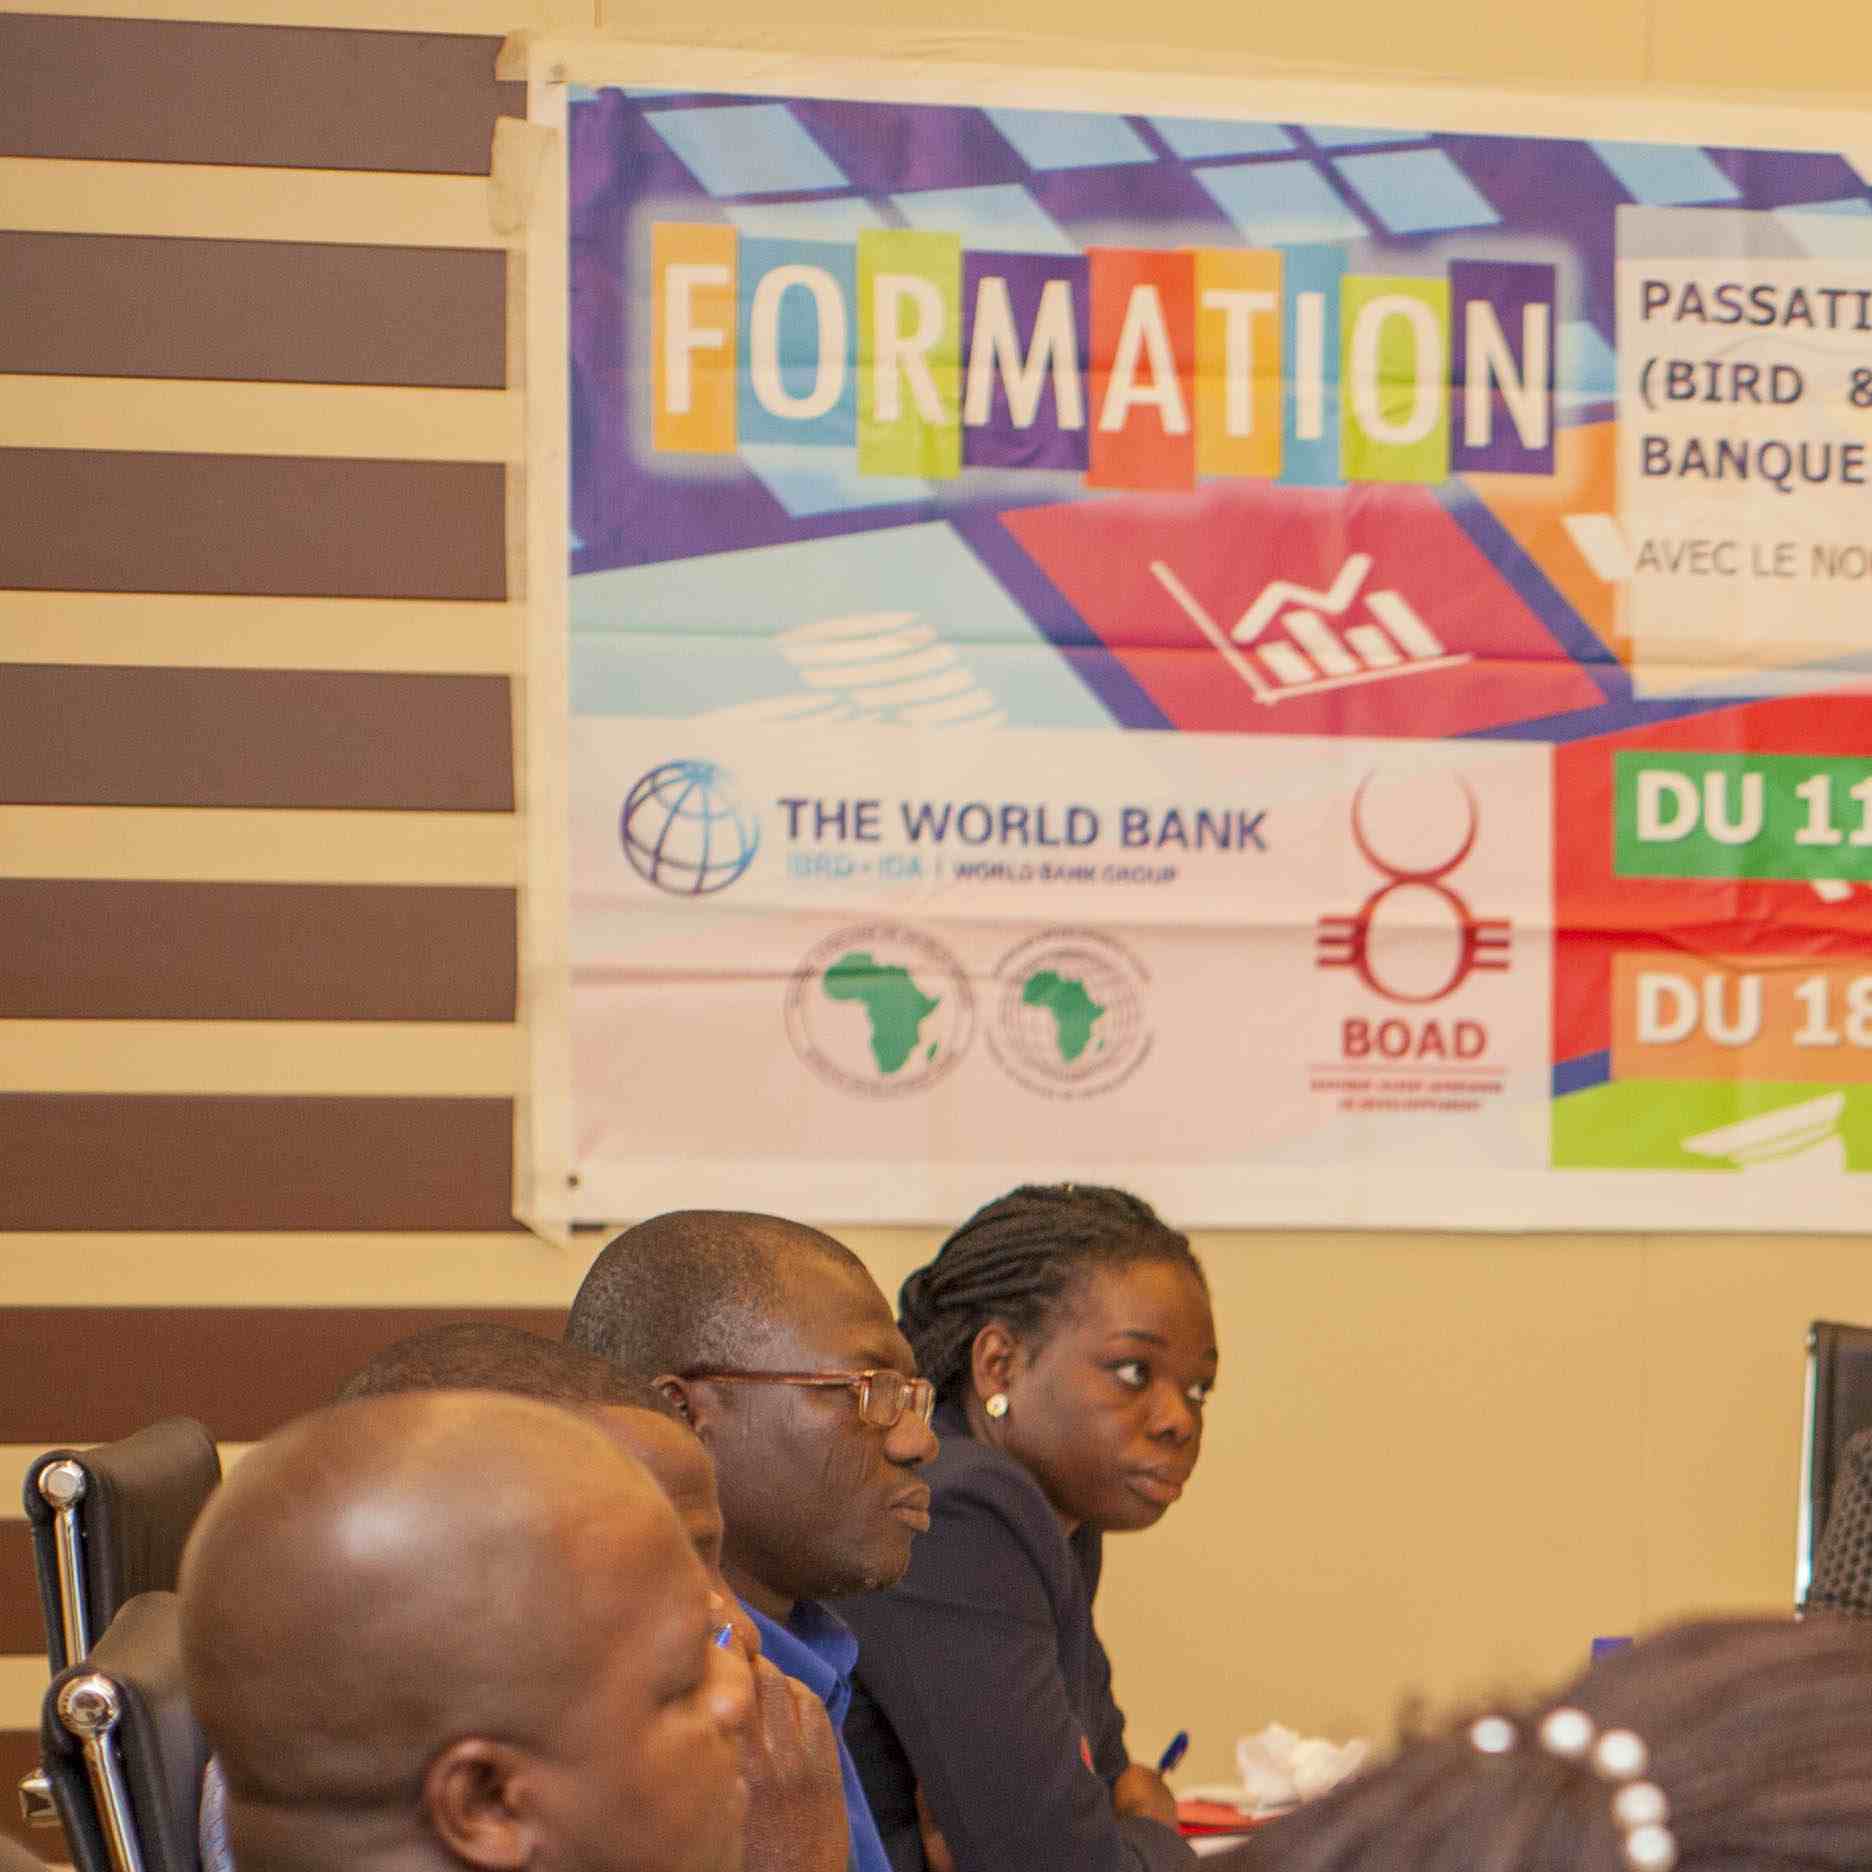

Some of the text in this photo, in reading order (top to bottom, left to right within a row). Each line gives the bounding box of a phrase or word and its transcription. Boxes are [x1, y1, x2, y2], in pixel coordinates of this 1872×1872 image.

[663, 261, 1551, 450] FORMATION
[1639, 357, 1804, 409] (BIRD
[1640, 435, 1866, 492] BANQUE
[1634, 539, 1737, 576] AVEC
[1752, 544, 1798, 578] LE
[778, 796, 1268, 855] THE WORLD BANK
[1636, 769, 1765, 844] DU
[953, 862, 1035, 882] WORLD
[1040, 862, 1096, 884] BANK
[1636, 971, 1763, 1048] DU
[1343, 1018, 1486, 1060] BOAD
